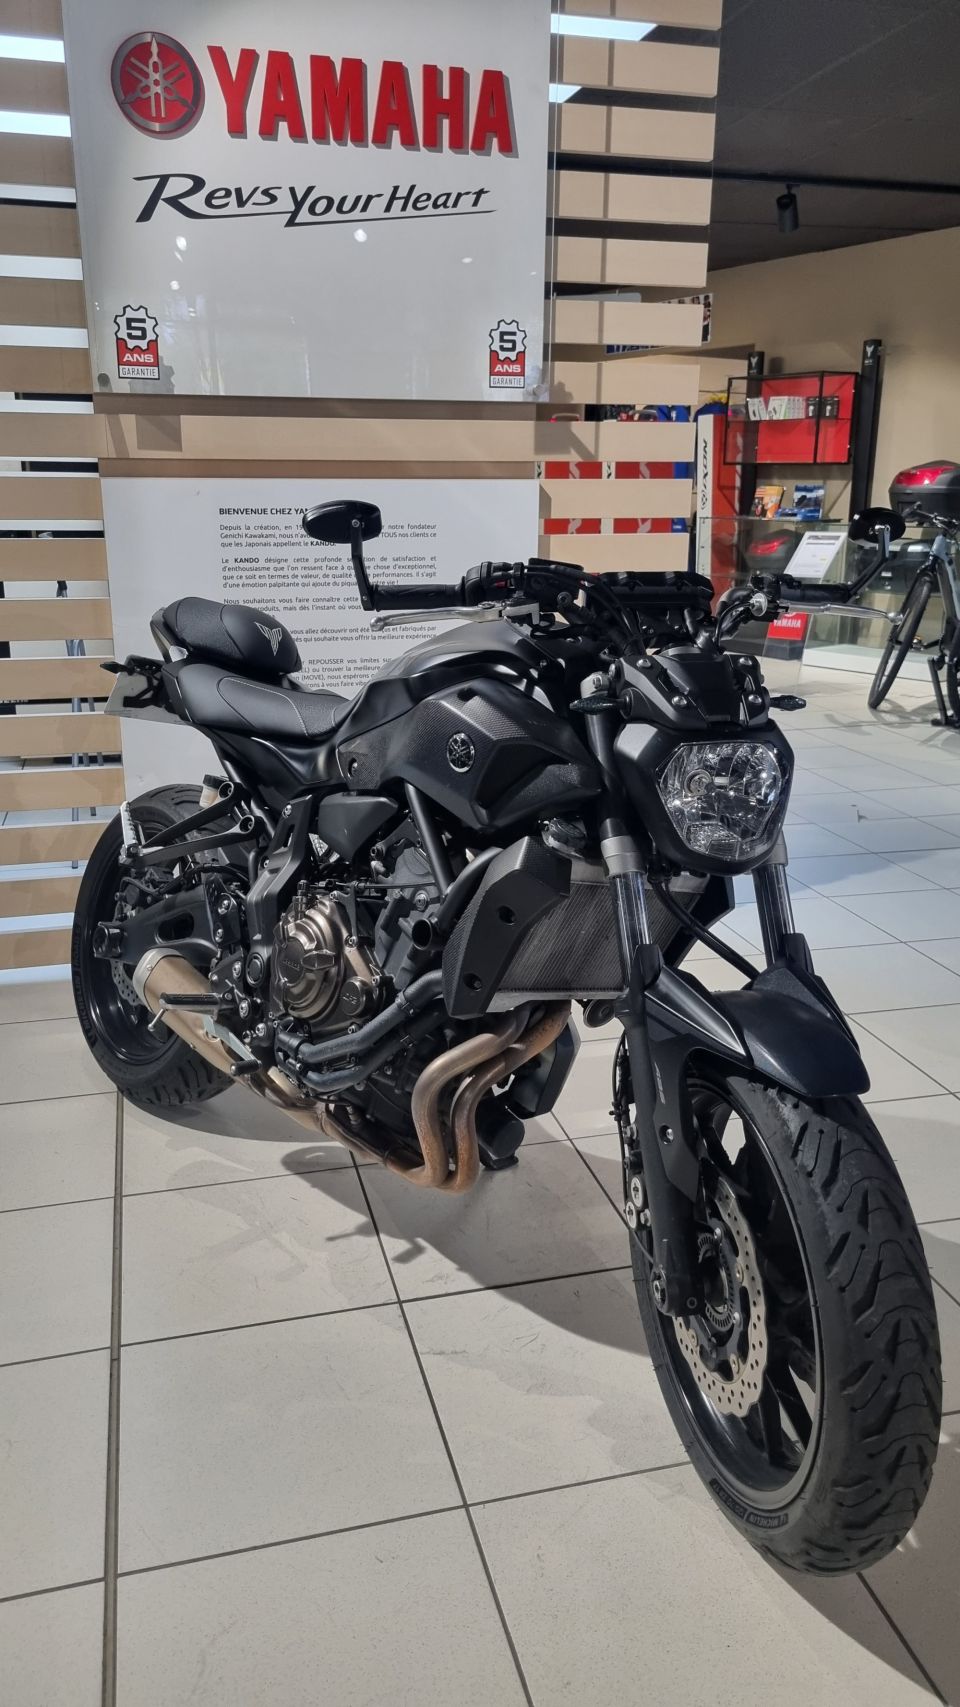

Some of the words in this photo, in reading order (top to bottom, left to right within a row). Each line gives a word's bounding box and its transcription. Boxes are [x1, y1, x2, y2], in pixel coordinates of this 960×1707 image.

[206, 45, 514, 155] YAMAHA
[132, 173, 284, 223] Revs
[281, 185, 384, 228] Your
[384, 184, 492, 214] Heart
[126, 317, 147, 340] 5
[499, 331, 517, 352] 5
[123, 353, 154, 362] ANS
[122, 368, 156, 376] GARANTIE
[494, 364, 521, 372] ANS
[492, 377, 523, 386] GARANTIE
[774, 618, 801, 628] YAMAHA
